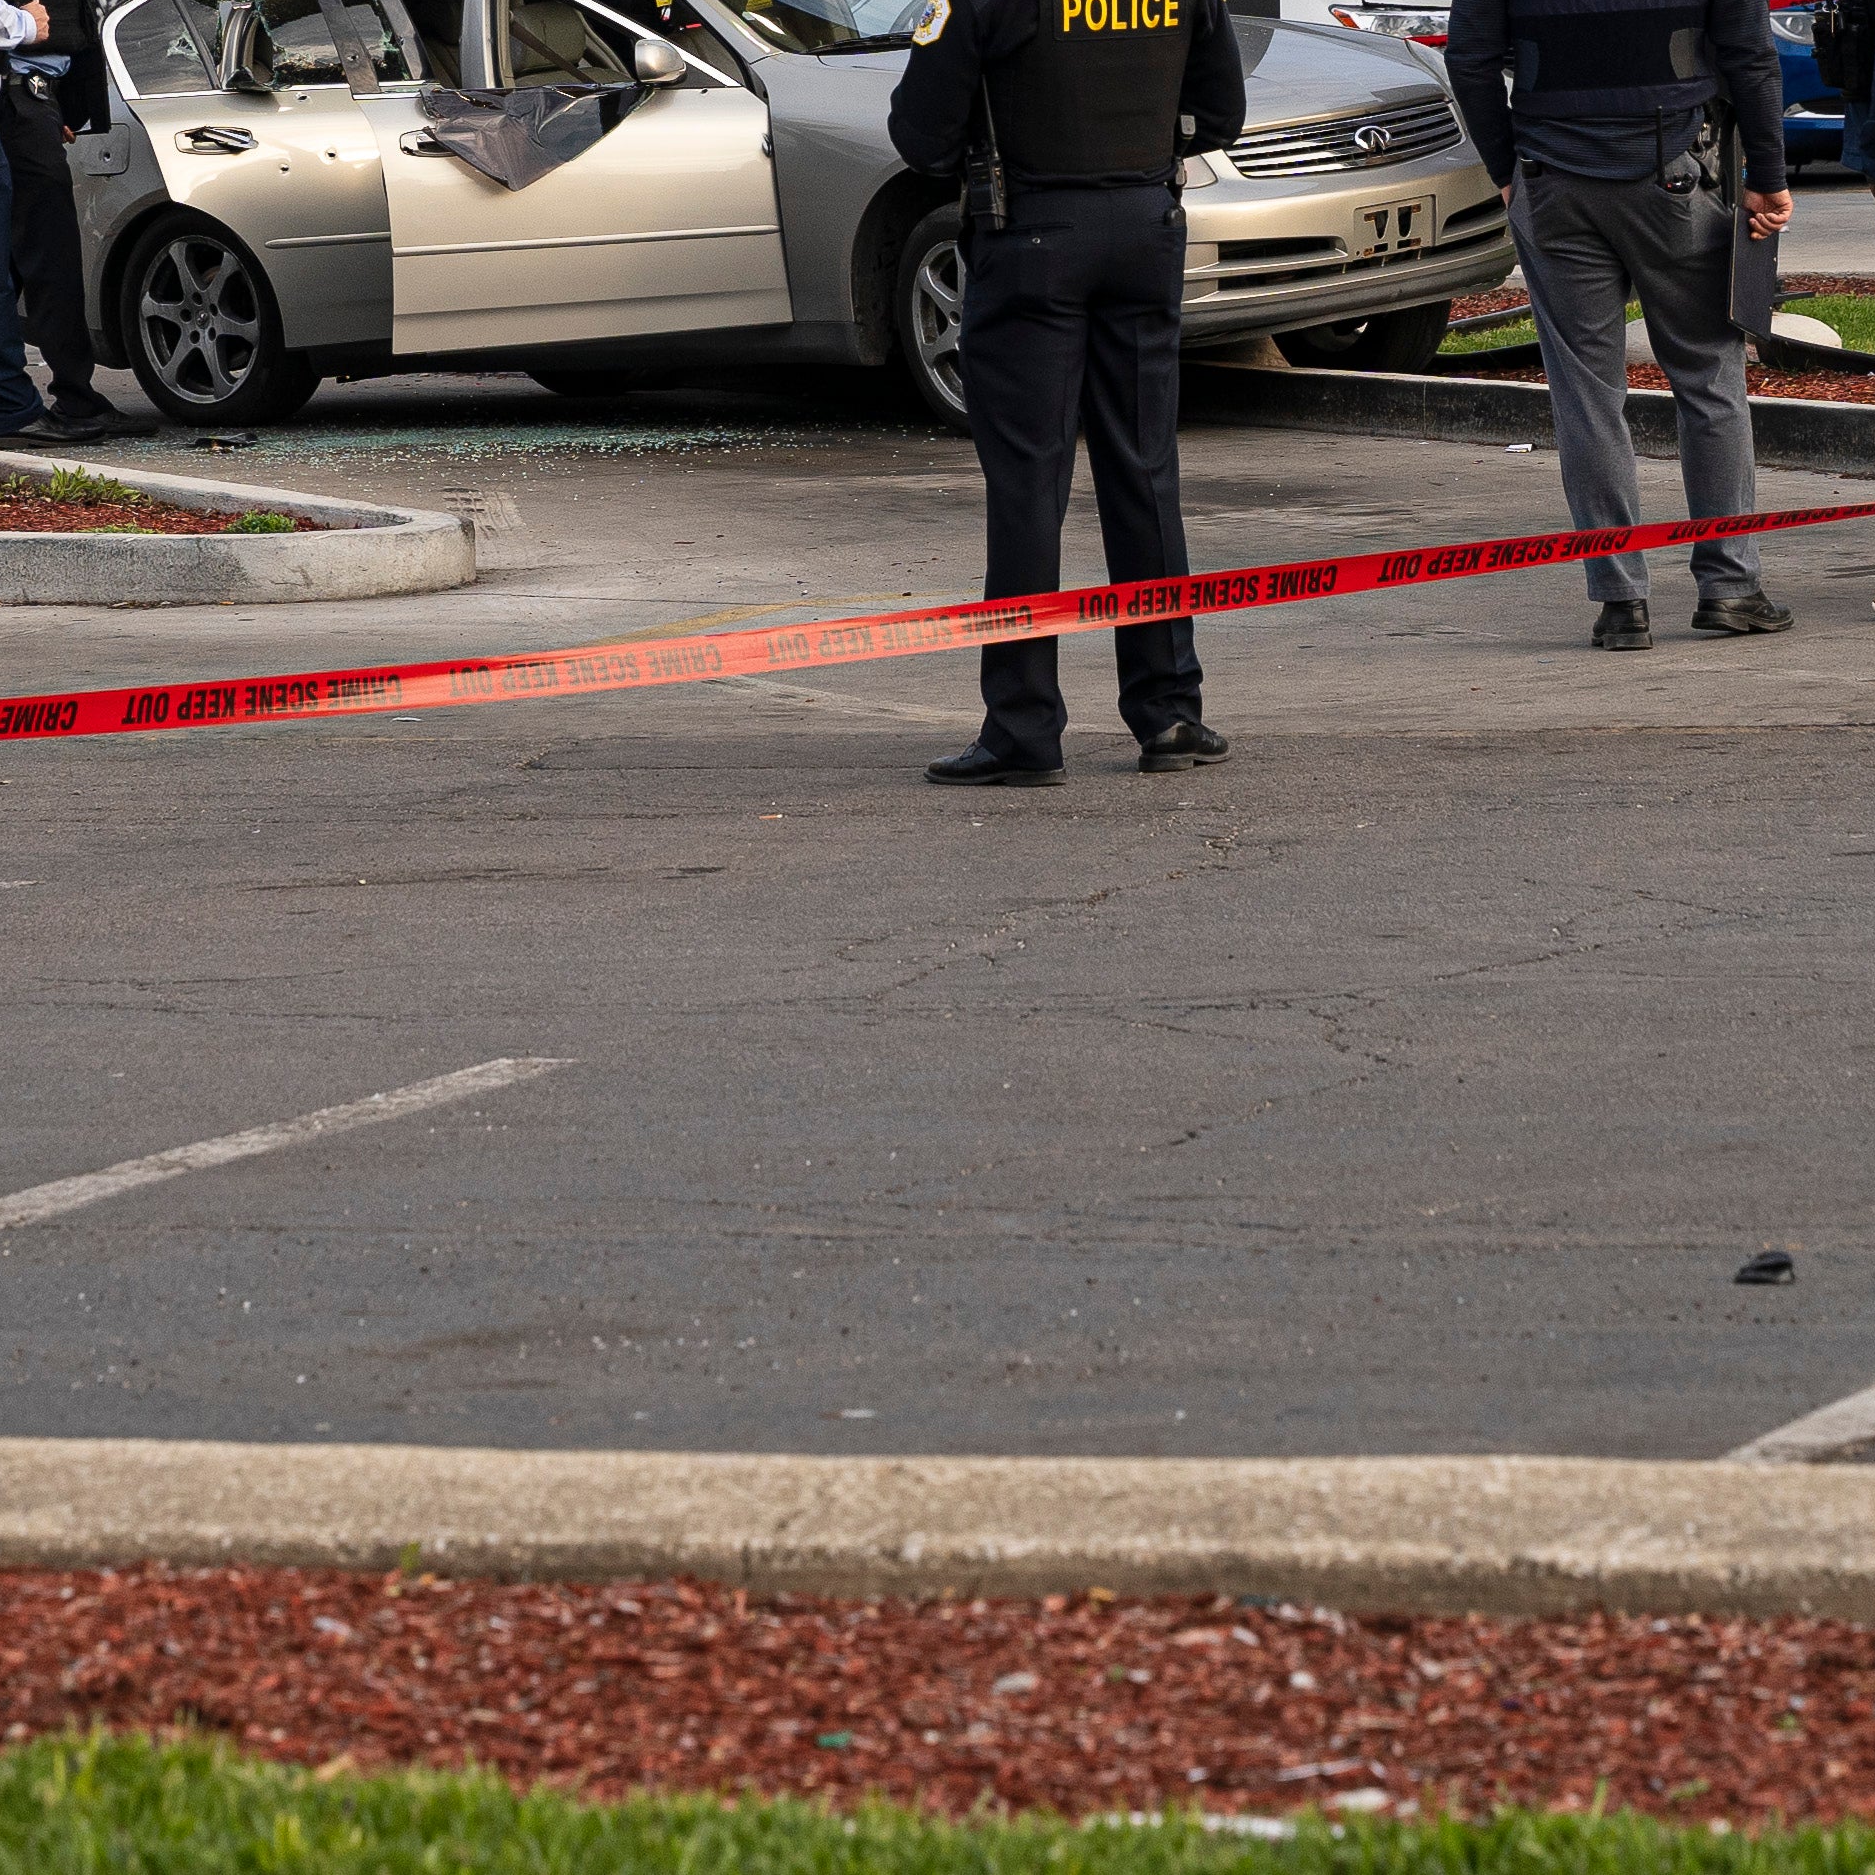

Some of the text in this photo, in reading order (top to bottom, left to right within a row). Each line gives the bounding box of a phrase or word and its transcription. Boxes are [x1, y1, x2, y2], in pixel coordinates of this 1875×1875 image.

[1376, 529, 1635, 583] CRIME SCENE KEEP OUT
[1667, 518, 1710, 541] OUT
[1075, 564, 1338, 625] CRIME SCENE KEEP OUT
[765, 604, 1033, 664] CRIME SCENE KEEP OUT
[448, 643, 722, 697] CRIME SCENE KEEP OUT
[120, 673, 403, 725] CRIME SCENE KEEP OUT
